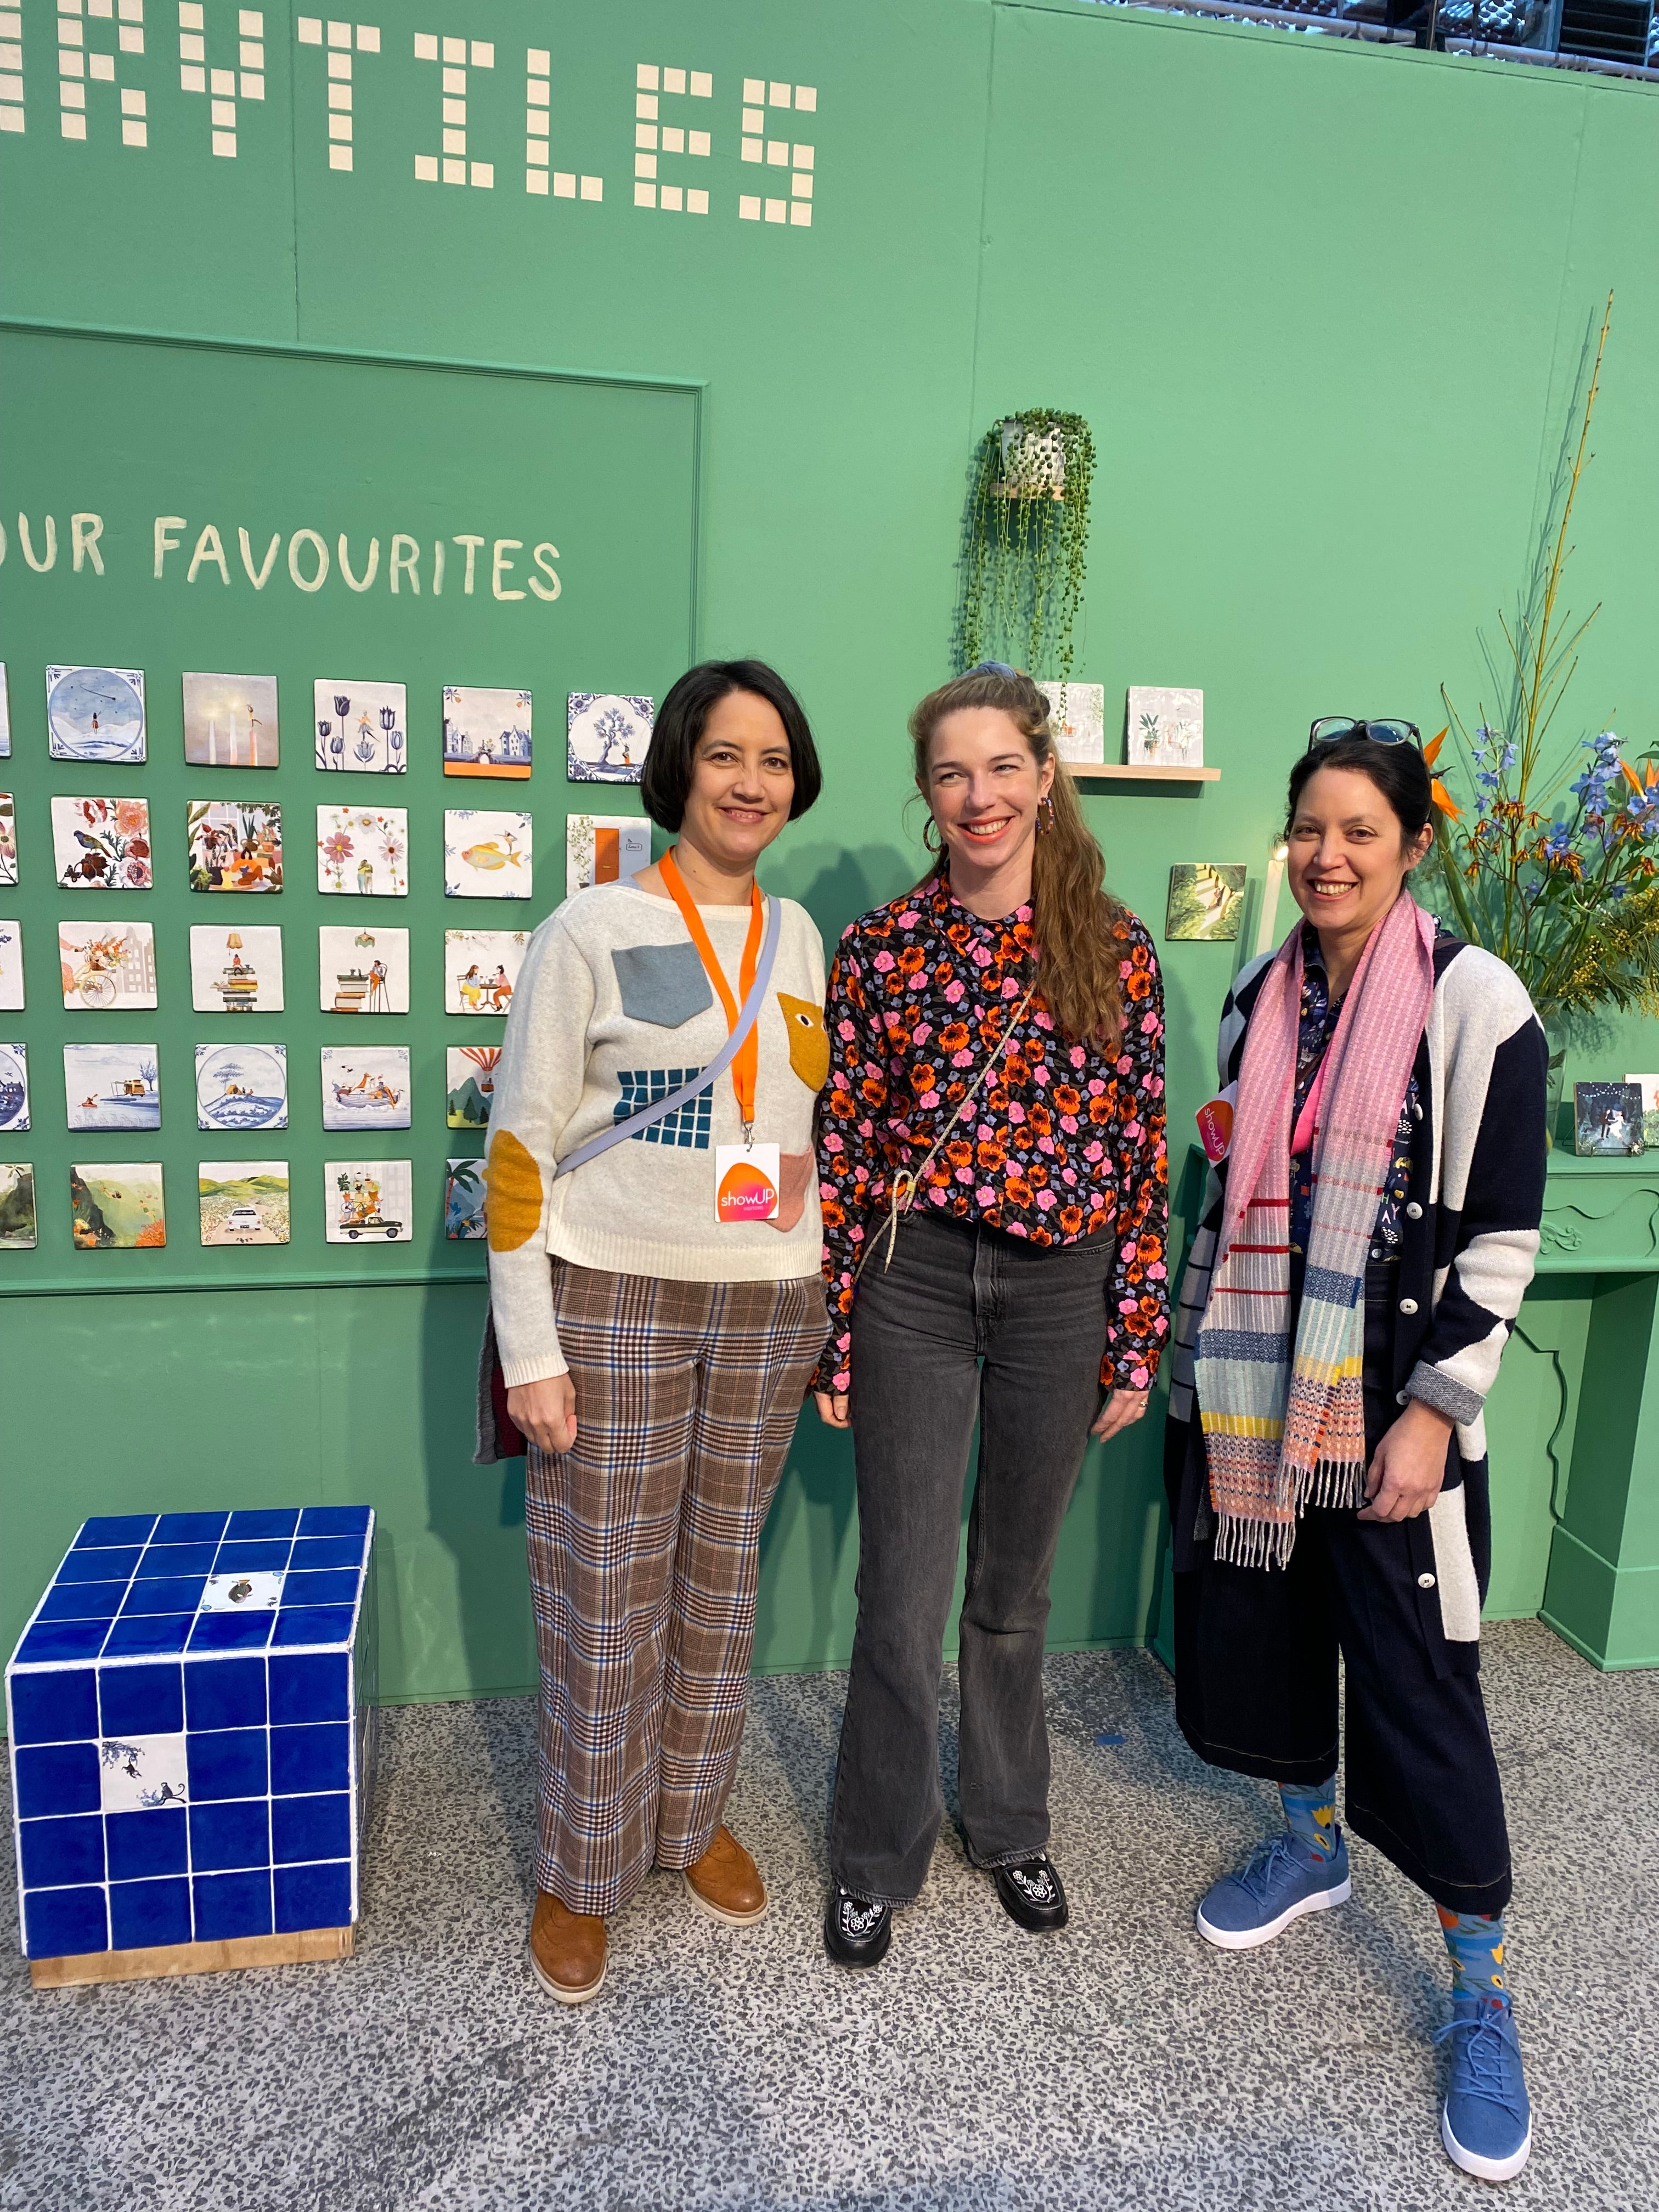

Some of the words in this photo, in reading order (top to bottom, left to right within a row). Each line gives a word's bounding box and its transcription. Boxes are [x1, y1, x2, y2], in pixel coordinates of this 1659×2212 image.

[0, 511, 105, 575] UR
[154, 516, 562, 601] FAVOURITES
[1205, 1108, 1224, 1155] showUP
[721, 1188, 775, 1206] showUP
